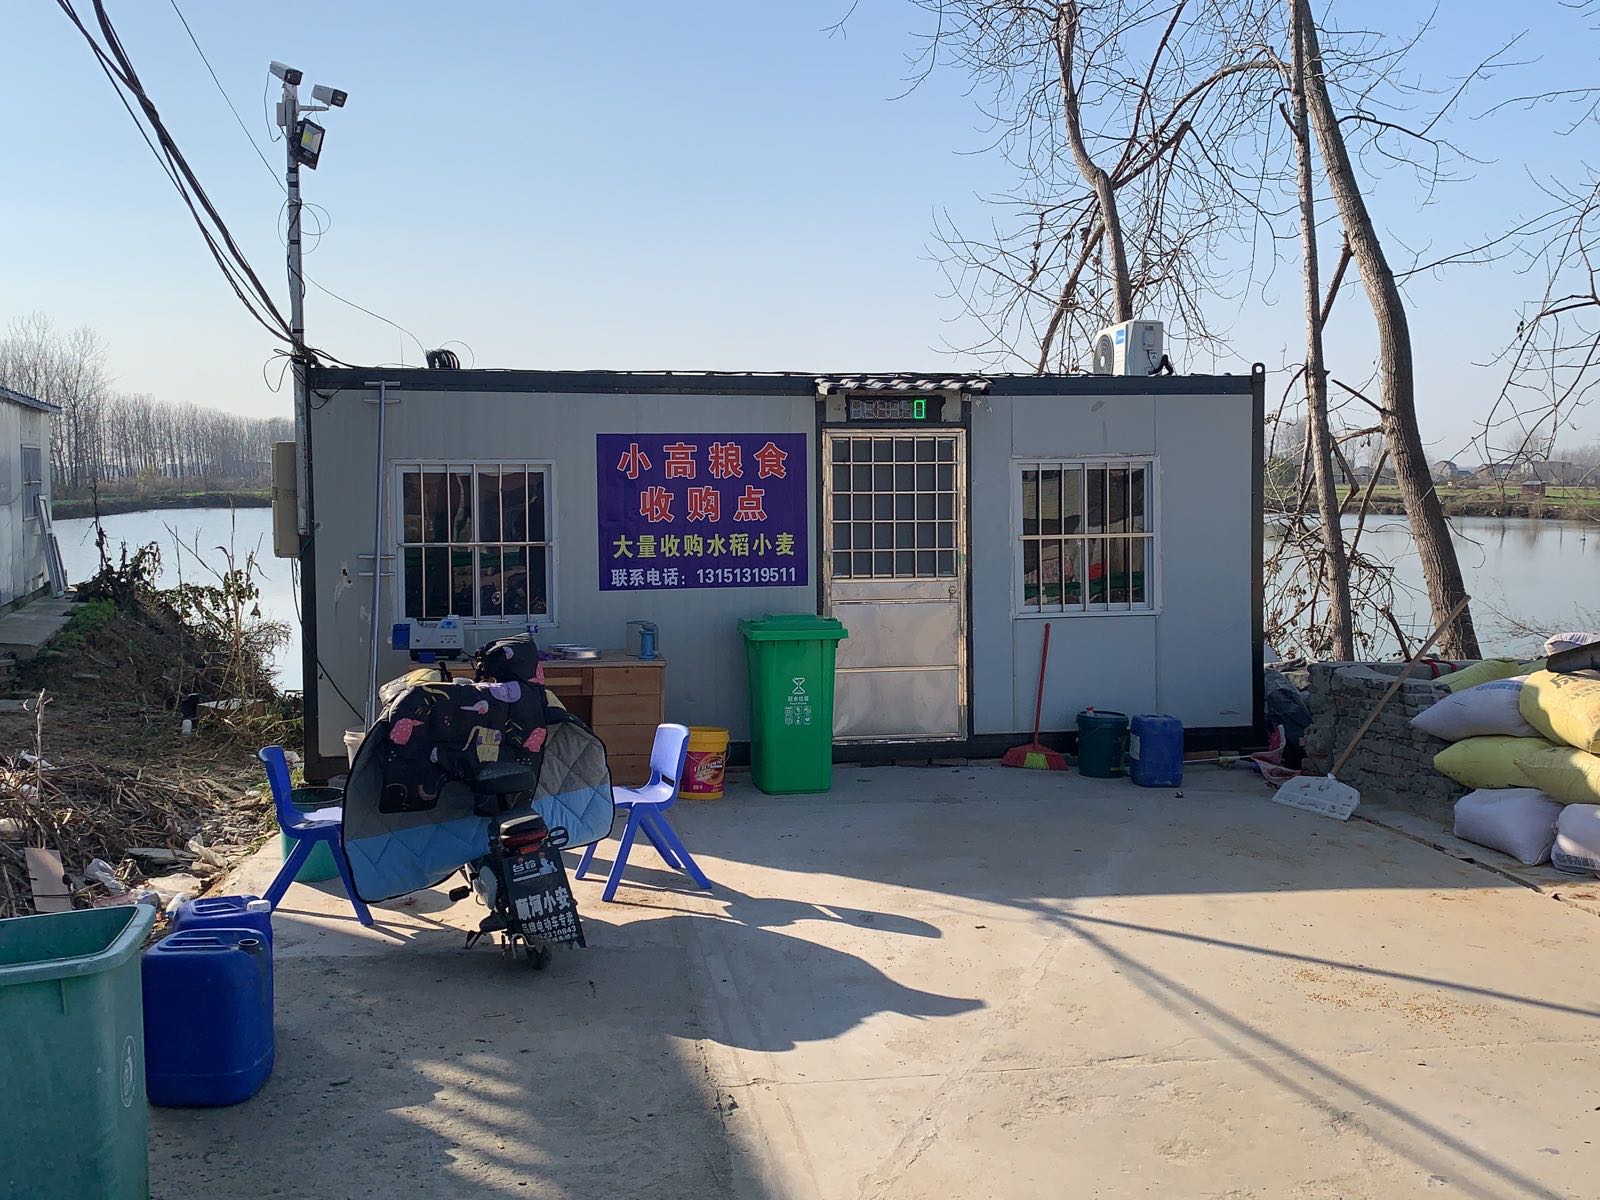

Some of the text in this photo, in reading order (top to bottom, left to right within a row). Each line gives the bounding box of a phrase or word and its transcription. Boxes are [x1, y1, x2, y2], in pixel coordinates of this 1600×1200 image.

[617, 442, 789, 479] 小高粮食
[640, 485, 768, 523] 收购点
[612, 532, 796, 559] 大量收购水稻小麦
[521, 911, 575, 934] 品牌电动车专卖
